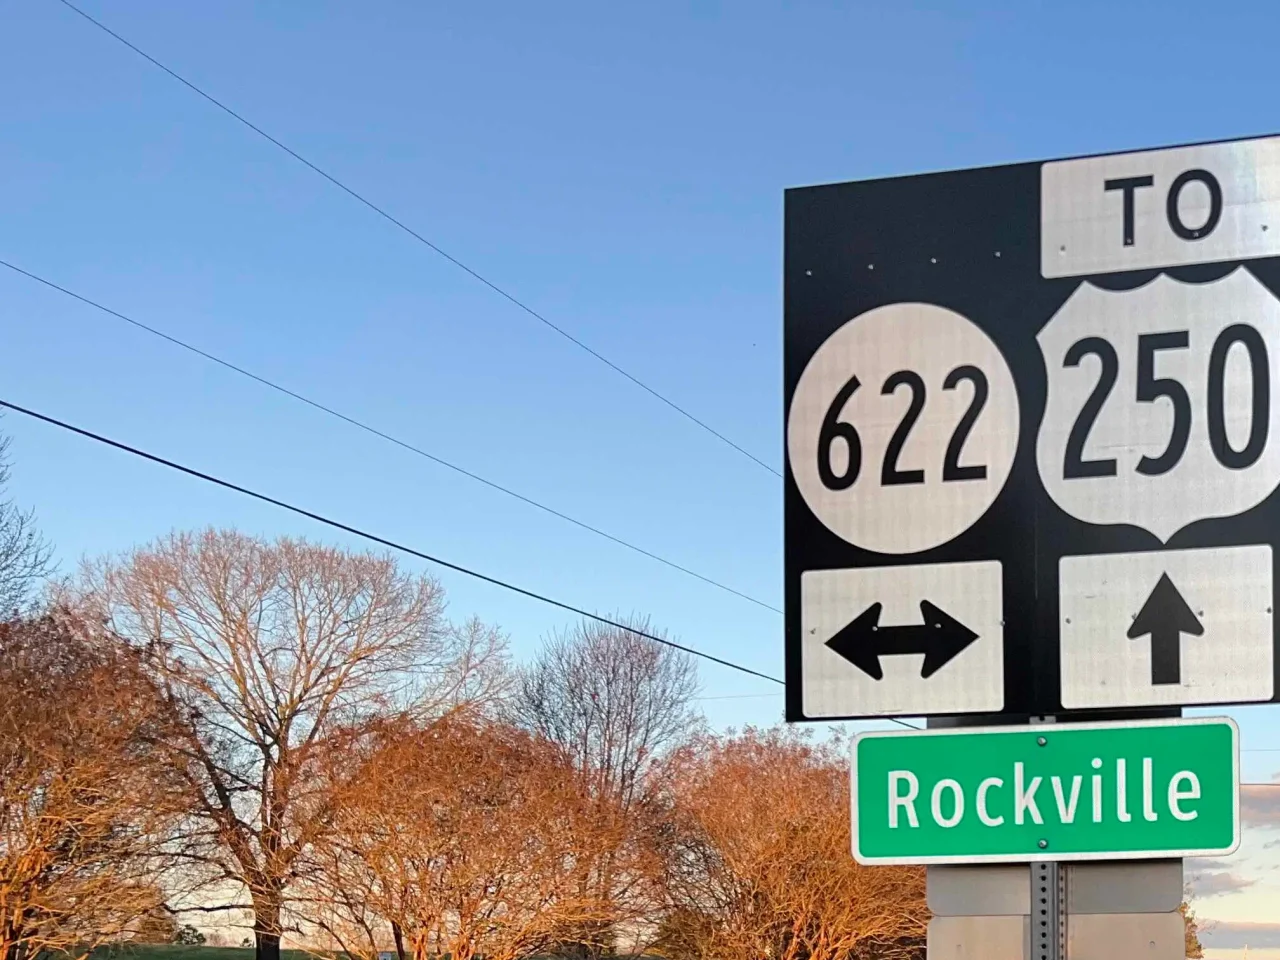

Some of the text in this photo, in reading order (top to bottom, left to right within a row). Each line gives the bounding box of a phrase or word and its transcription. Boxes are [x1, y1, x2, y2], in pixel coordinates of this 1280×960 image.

[1104, 168, 1223, 247] TO
[816, 364, 989, 491] 622
[1062, 323, 1271, 481] 250
[887, 757, 1202, 829] Rockville
